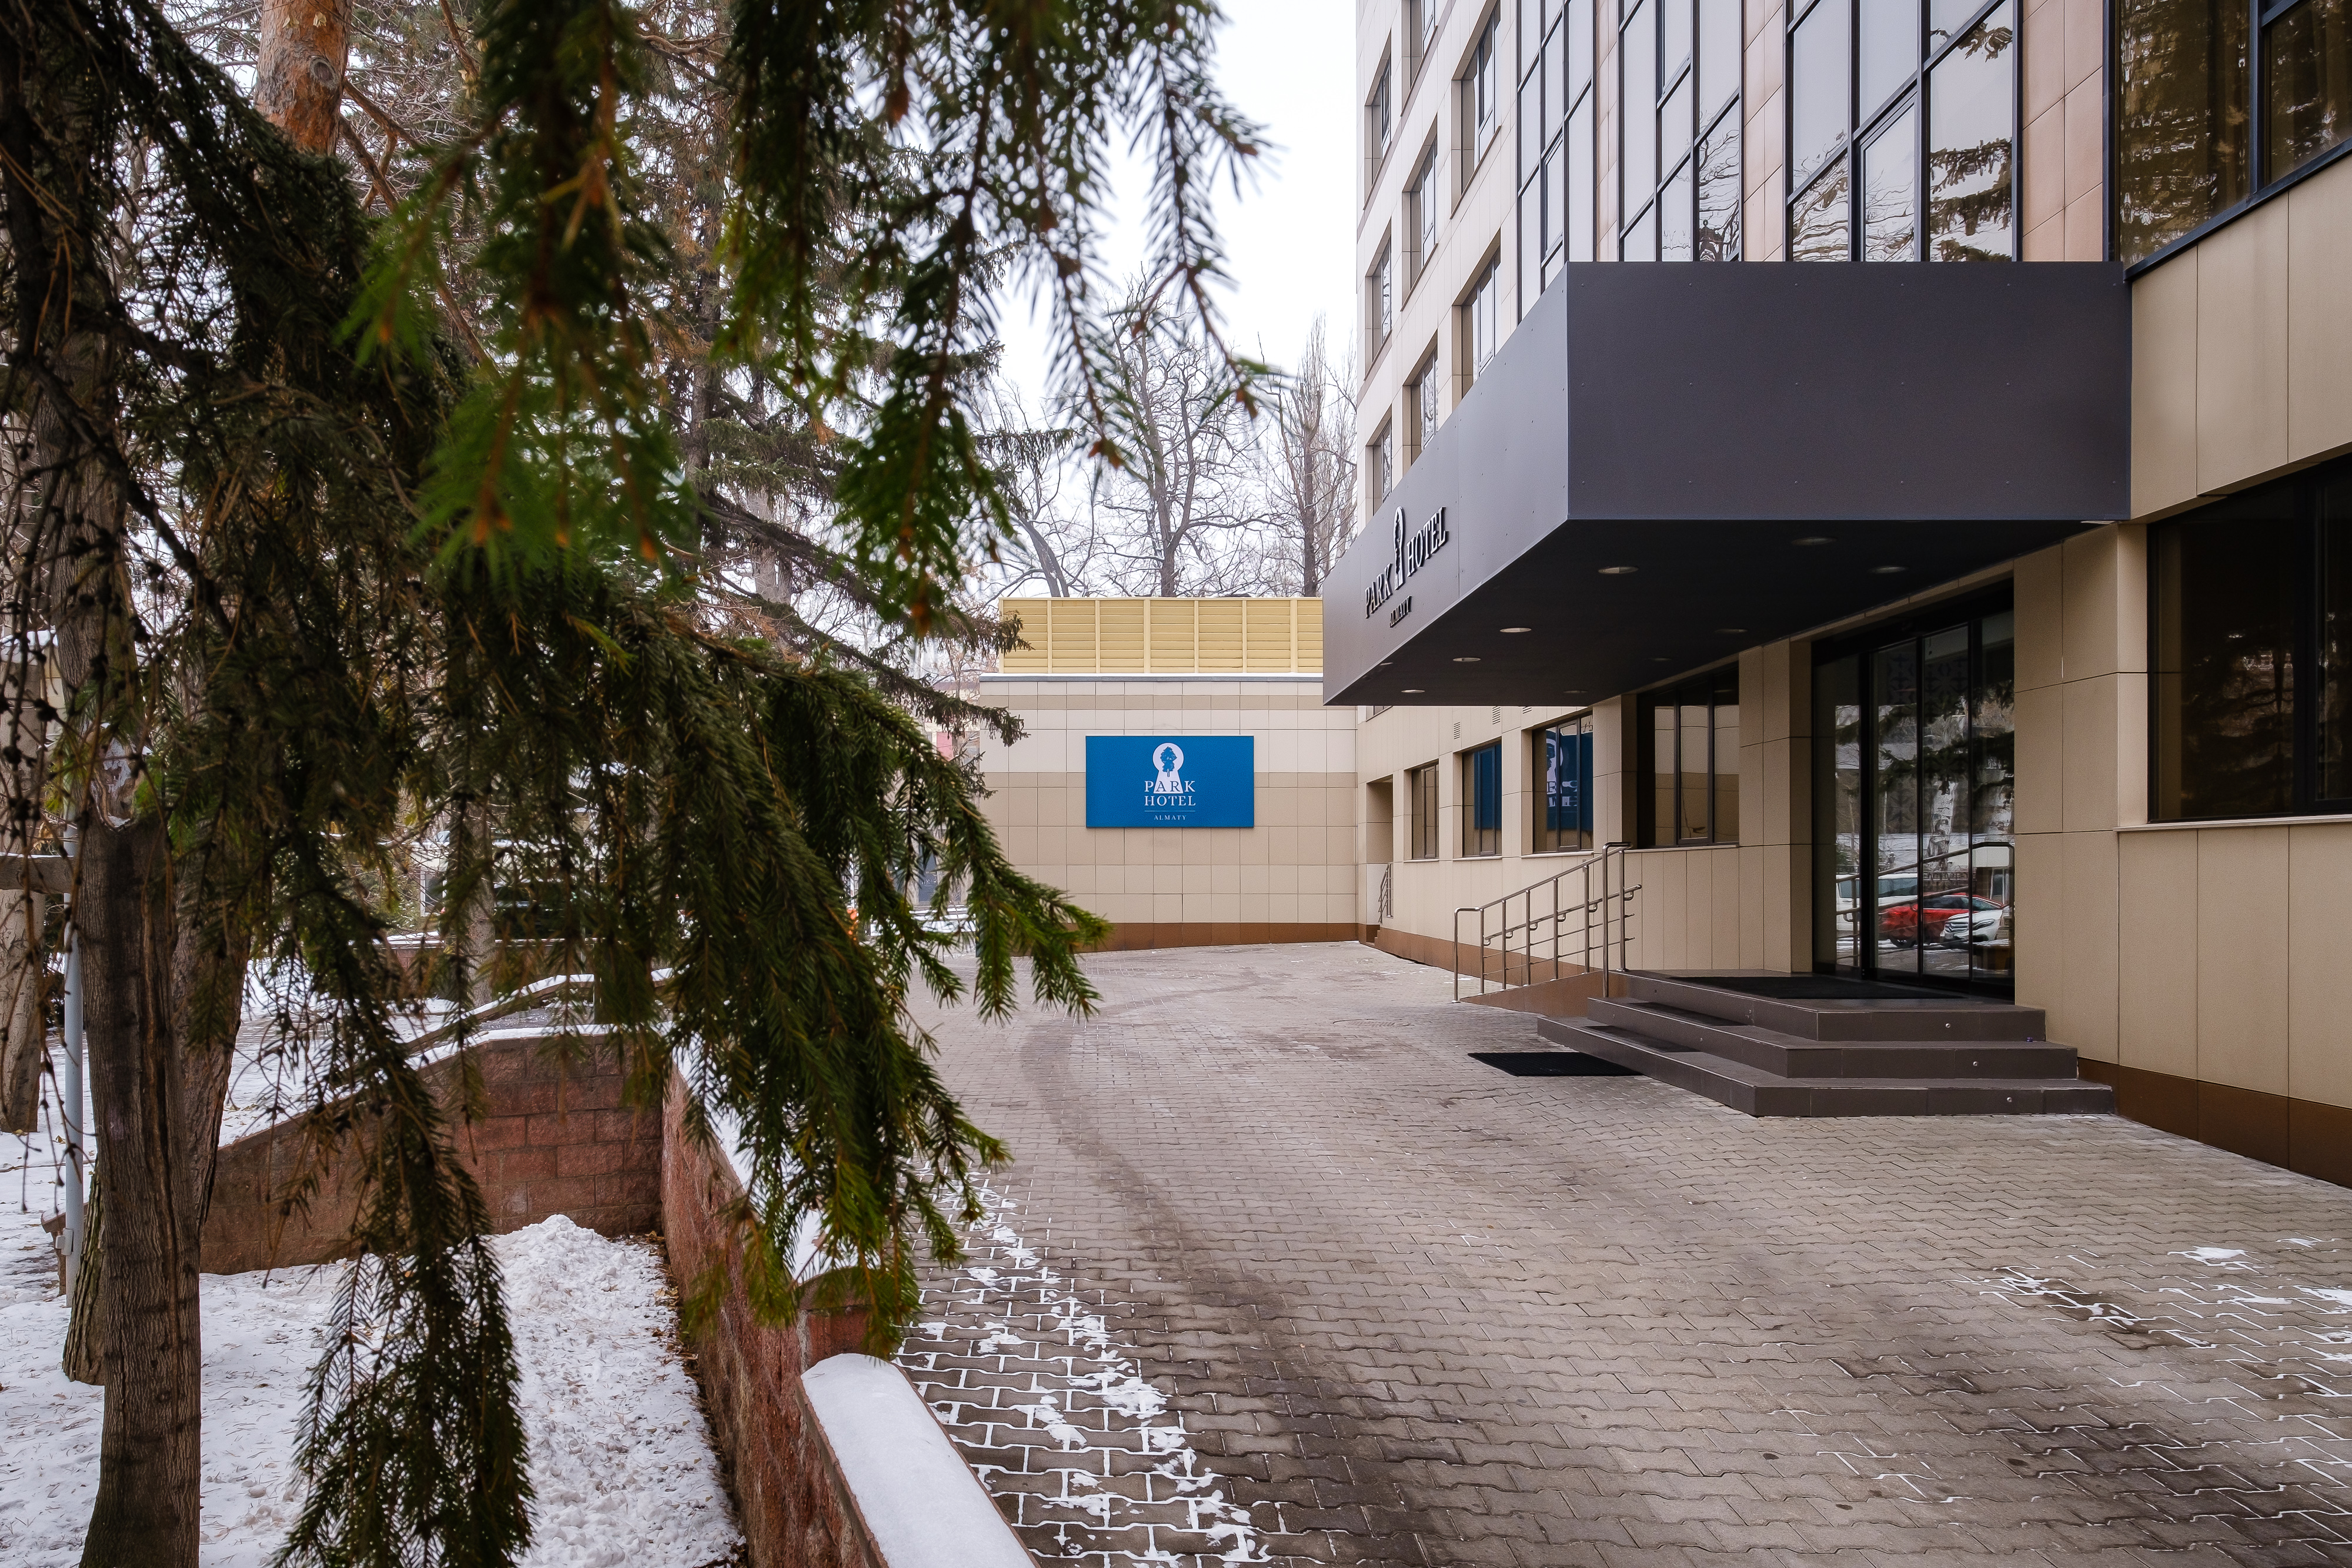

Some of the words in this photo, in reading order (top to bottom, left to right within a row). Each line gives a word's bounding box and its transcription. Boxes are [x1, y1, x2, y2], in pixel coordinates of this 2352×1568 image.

[1365, 563, 1392, 618] PARK
[1406, 507, 1448, 577] HOTEL
[1389, 595, 1412, 627] ALMATY
[1144, 781, 1195, 792] PARK
[1144, 795, 1195, 806] HOTEL
